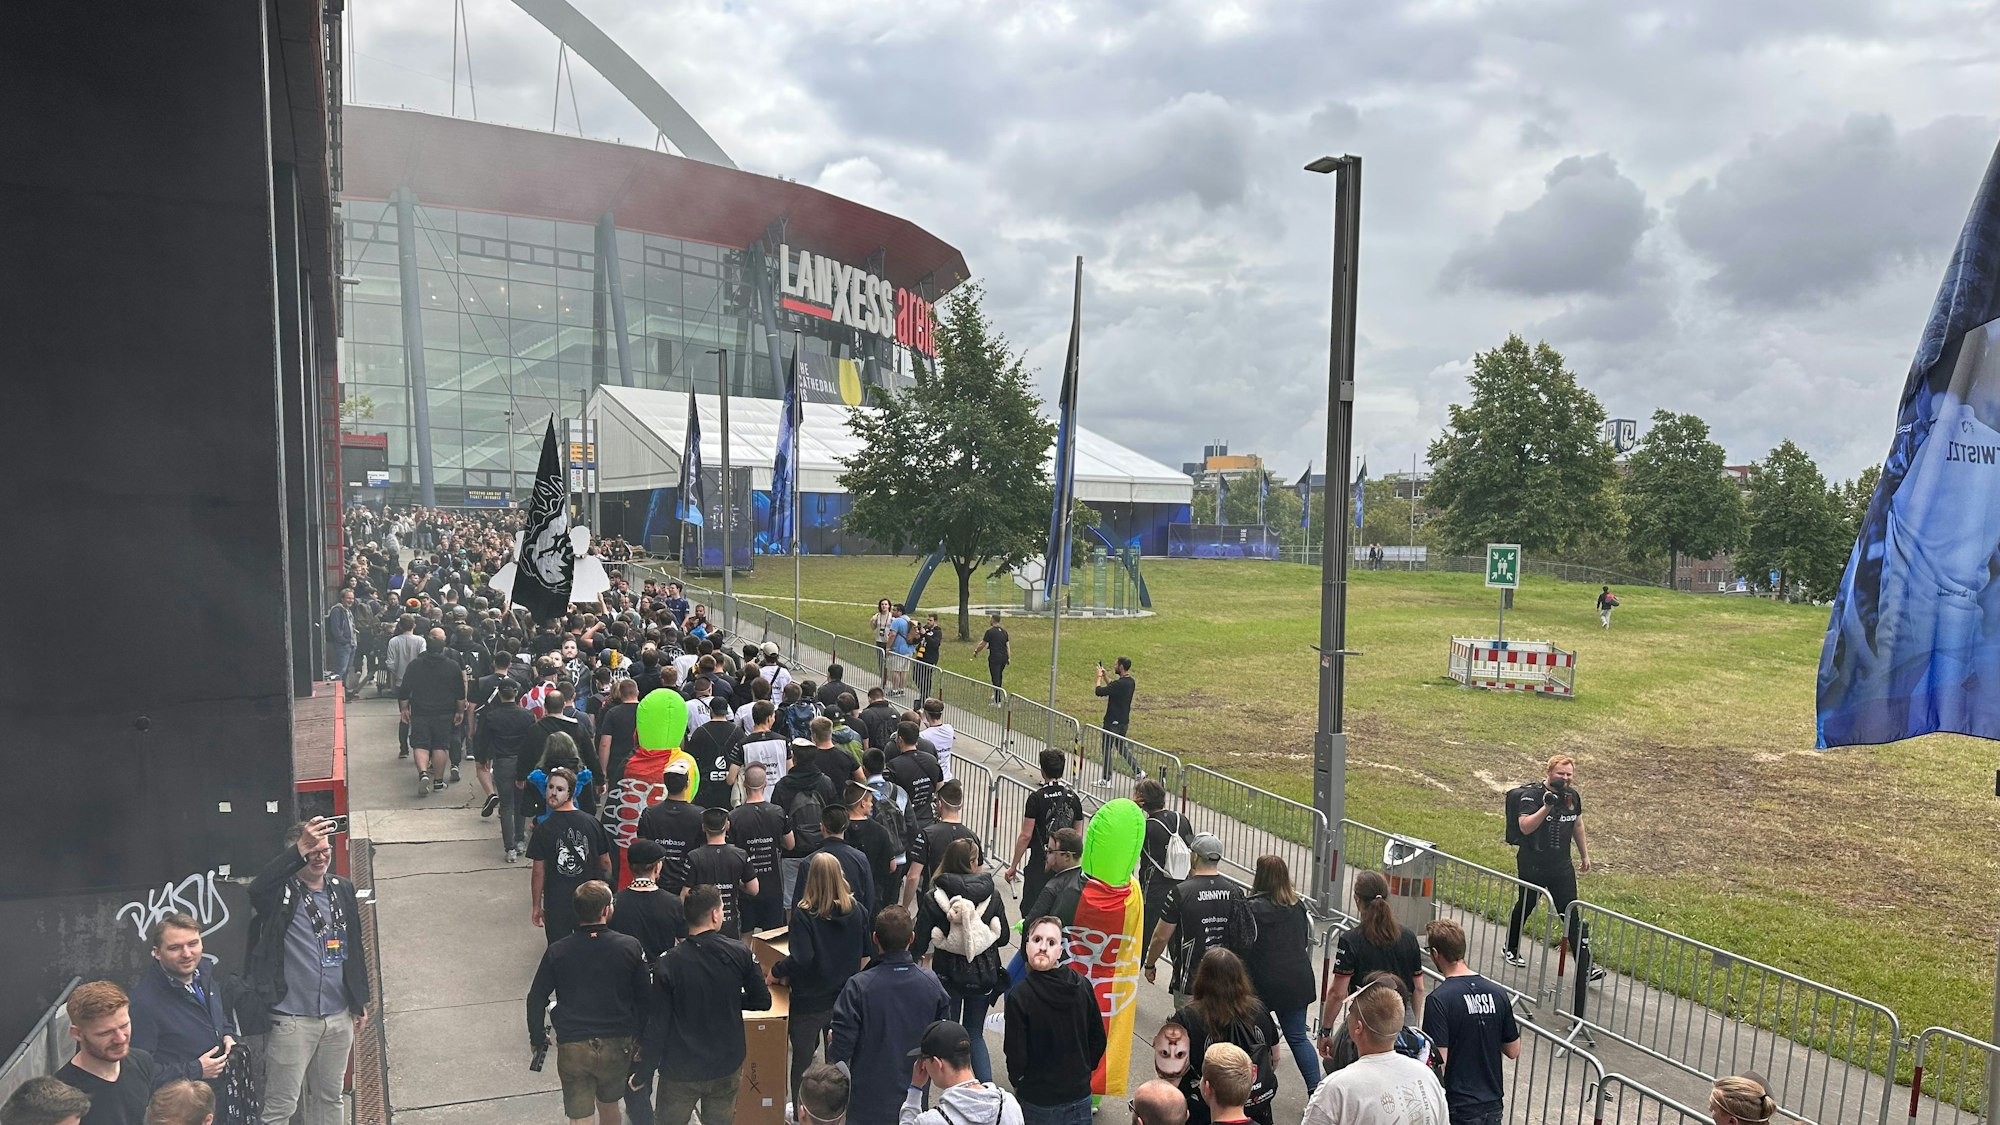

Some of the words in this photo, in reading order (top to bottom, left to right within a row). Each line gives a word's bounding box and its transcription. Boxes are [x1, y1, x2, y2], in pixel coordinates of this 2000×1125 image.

[780, 243, 893, 338] LANXESS
[799, 361, 809, 376] HE
[1197, 890, 1231, 901] JOHNNYYY
